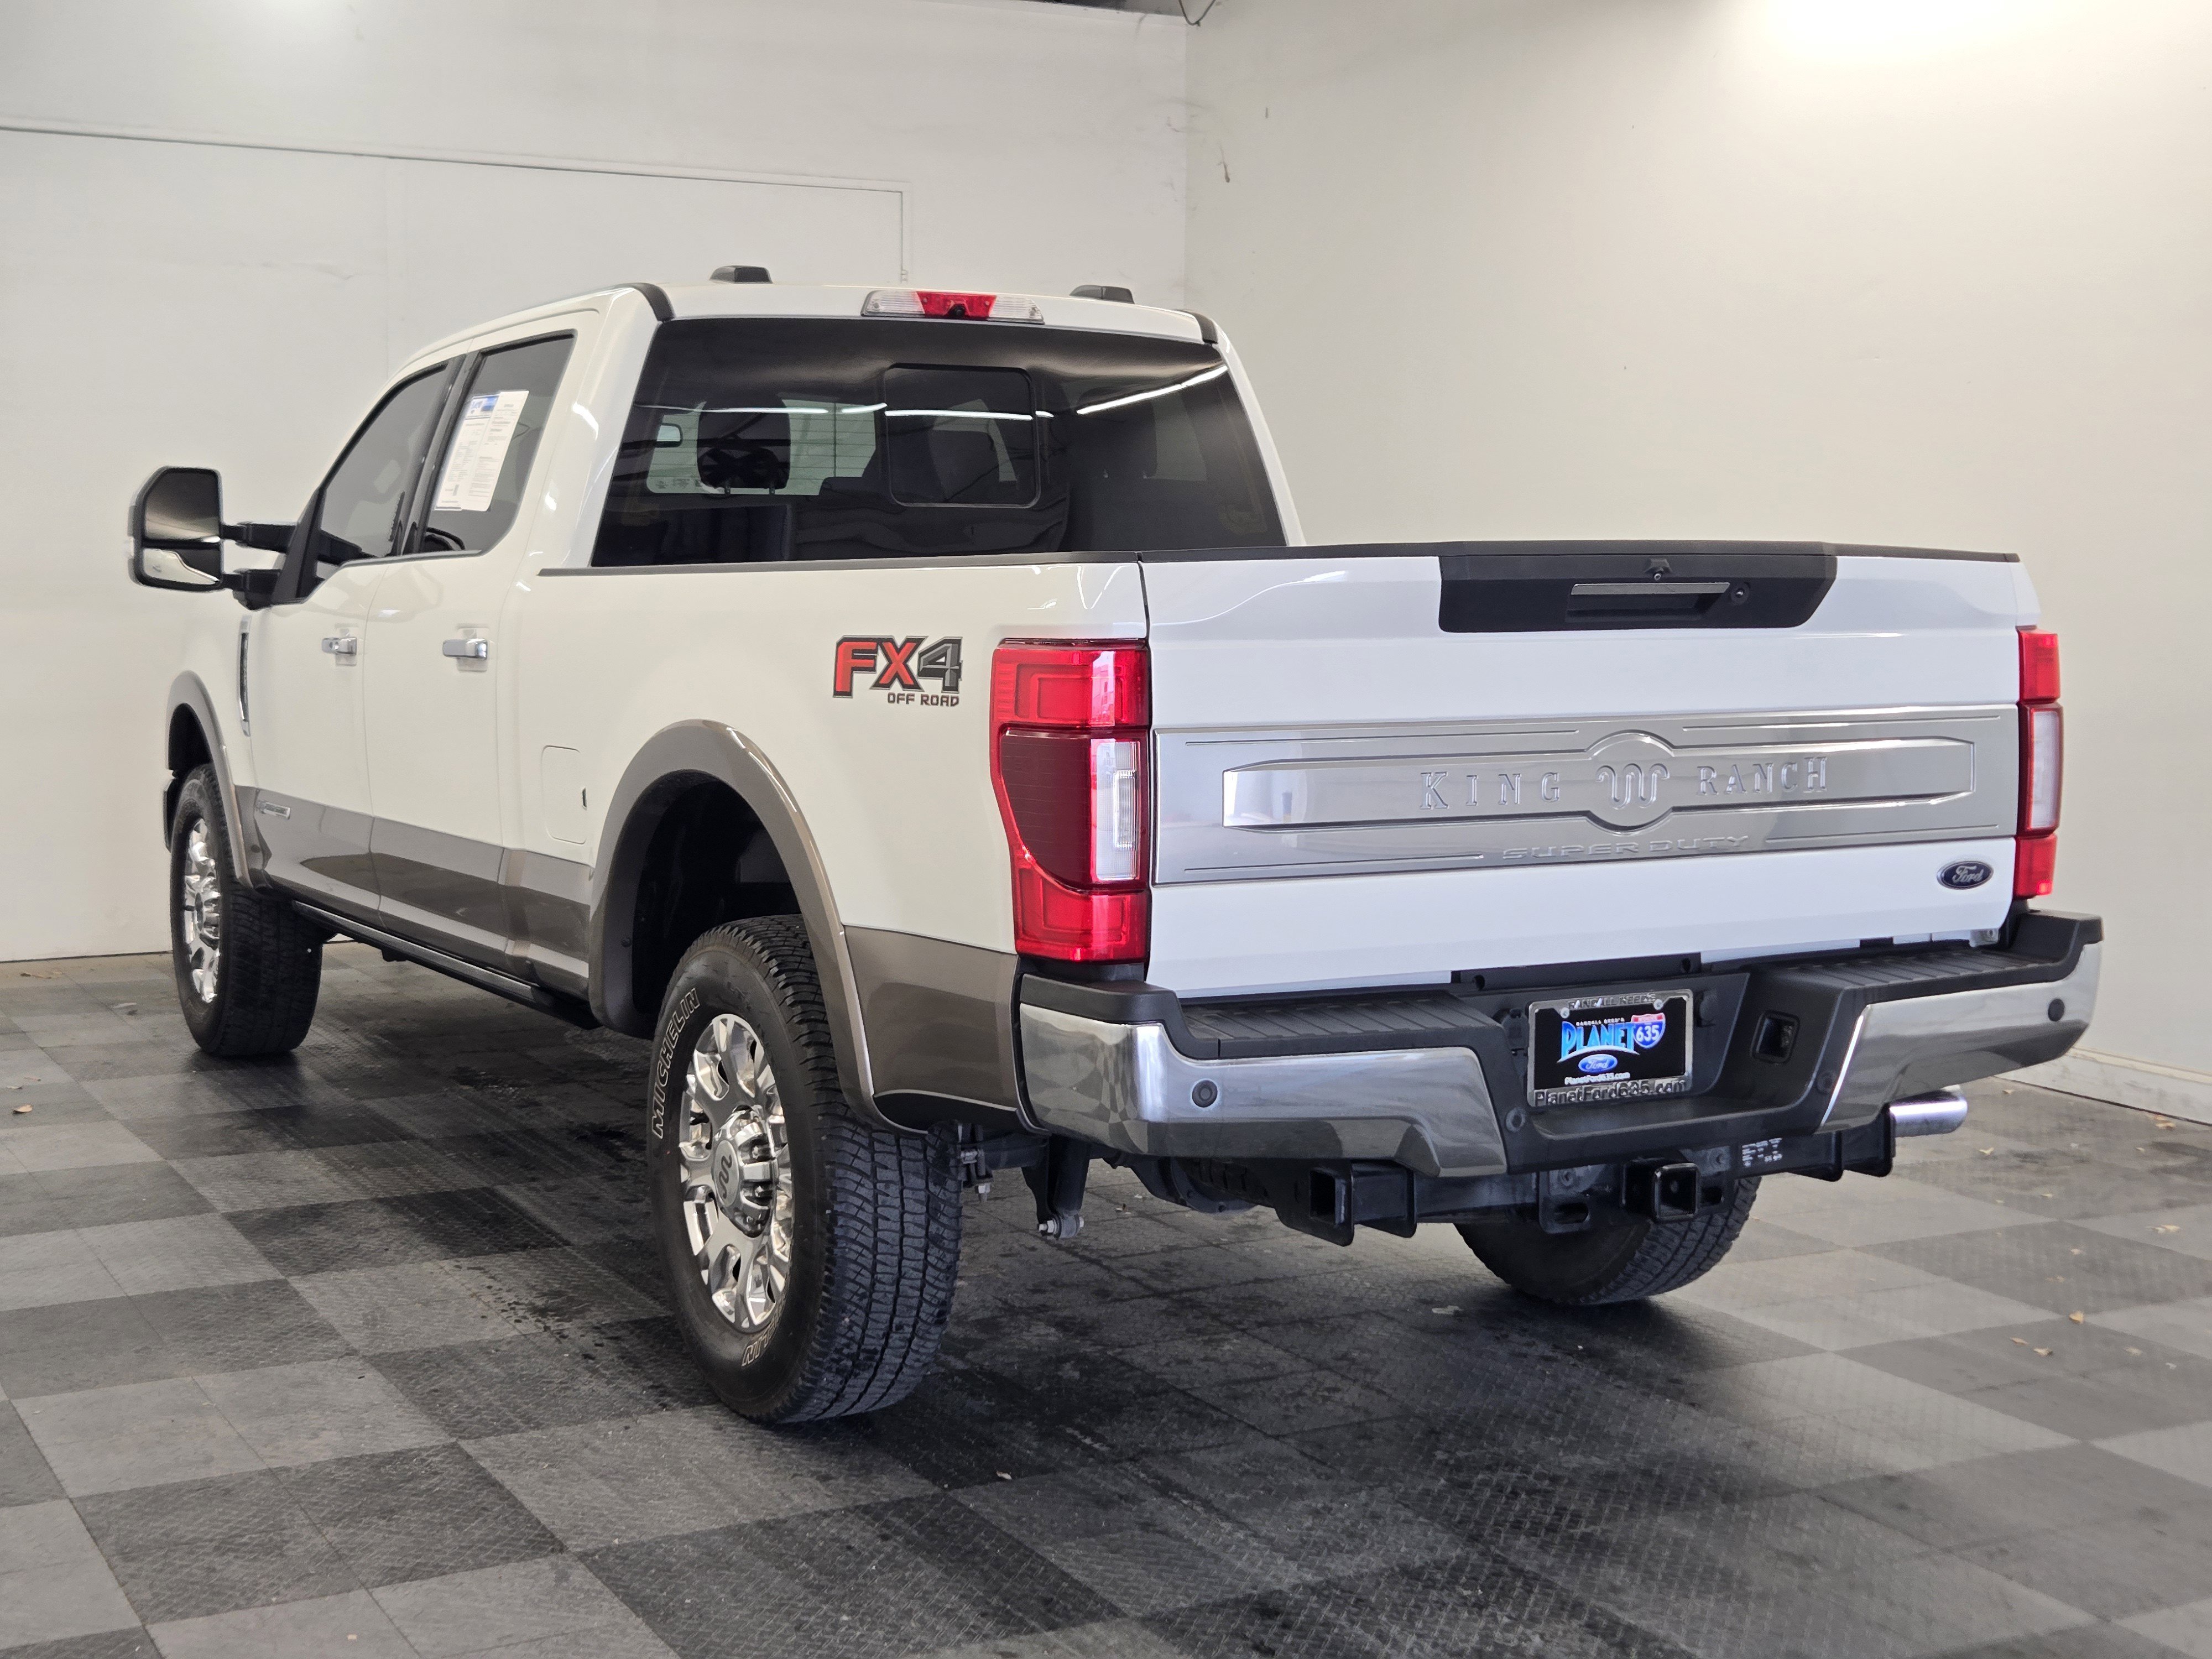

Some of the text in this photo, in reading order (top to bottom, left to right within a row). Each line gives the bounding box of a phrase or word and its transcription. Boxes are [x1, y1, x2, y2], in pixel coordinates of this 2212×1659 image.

[833, 635, 963, 698] FX4
[887, 692, 959, 707] OFF ROAD
[1420, 757, 1827, 810] KING RANCH
[1503, 835, 1749, 859] SUPER DUTY
[1952, 865, 1984, 883] Ford
[1561, 1021, 1660, 1058] PLANET 635
[652, 988, 701, 1139] MICHELIN
[1585, 1057, 1611, 1070] Ford
